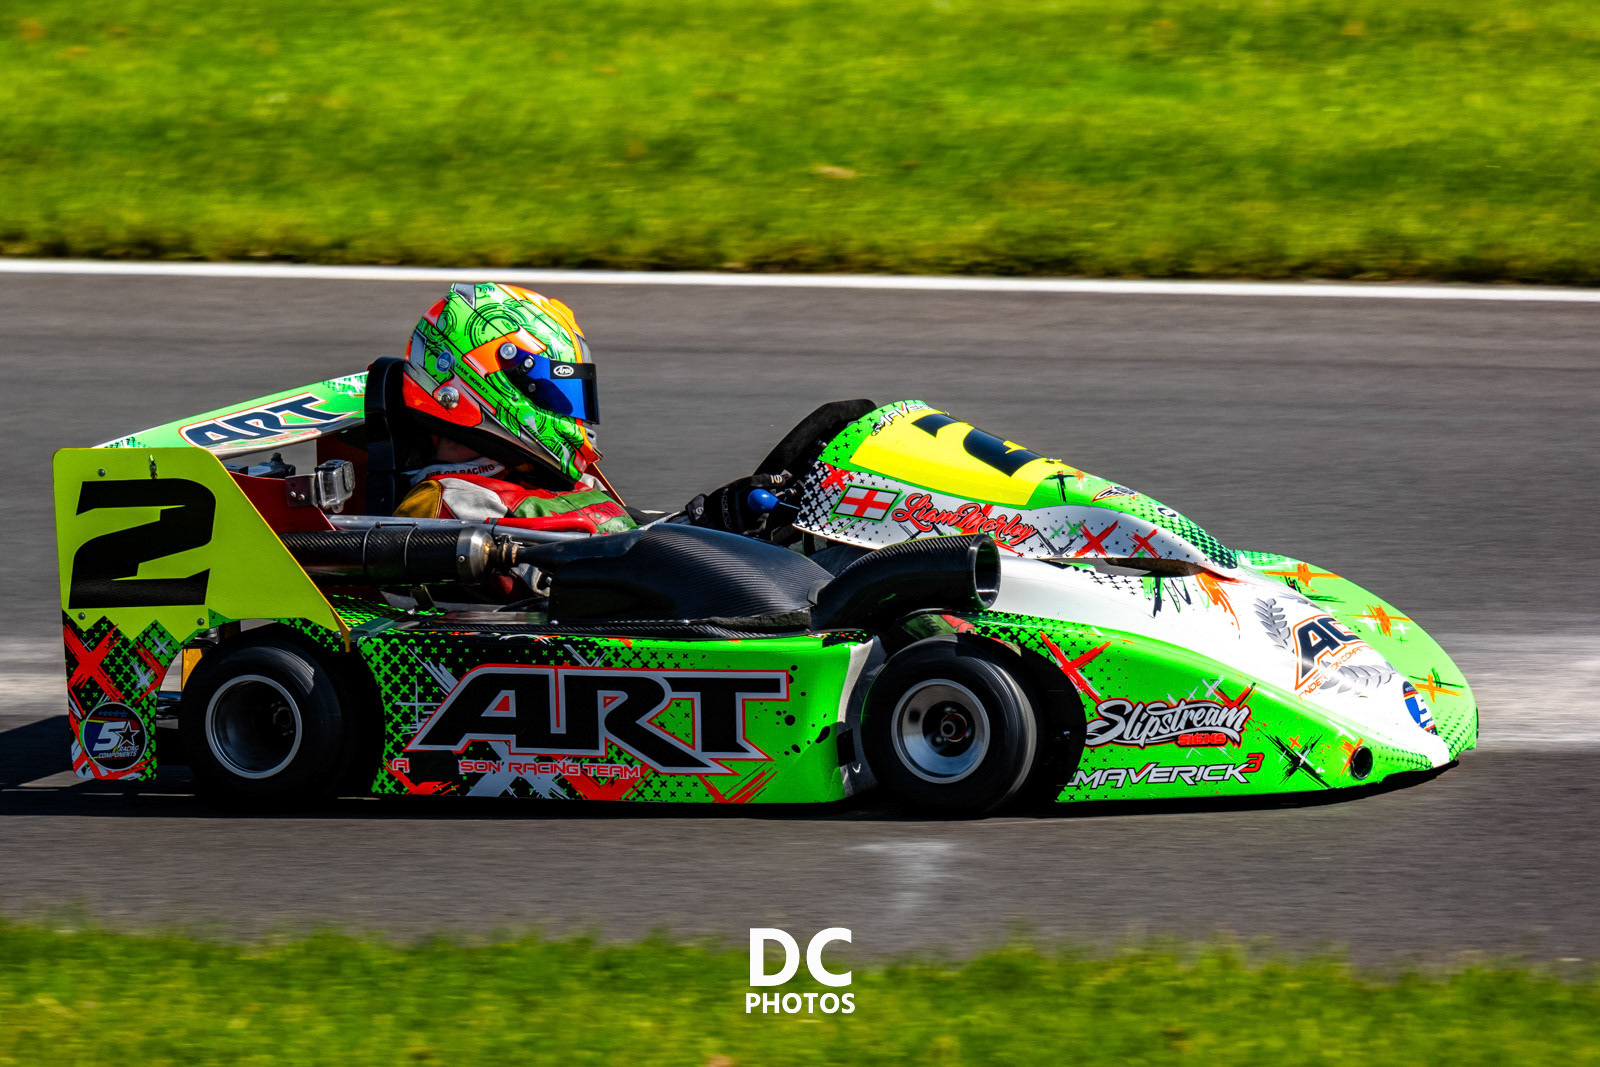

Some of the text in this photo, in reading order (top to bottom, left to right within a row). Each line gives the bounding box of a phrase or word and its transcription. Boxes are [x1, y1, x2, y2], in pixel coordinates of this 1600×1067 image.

[182, 394, 350, 447] ART
[68, 478, 216, 609] 2
[892, 493, 1038, 546] Liam Morley
[93, 721, 127, 751] 5
[404, 665, 788, 775] ART
[1086, 699, 1250, 748] Slipstream
[1177, 733, 1227, 746] SIGNS
[508, 762, 580, 776] RACING
[583, 763, 641, 780] TEAM
